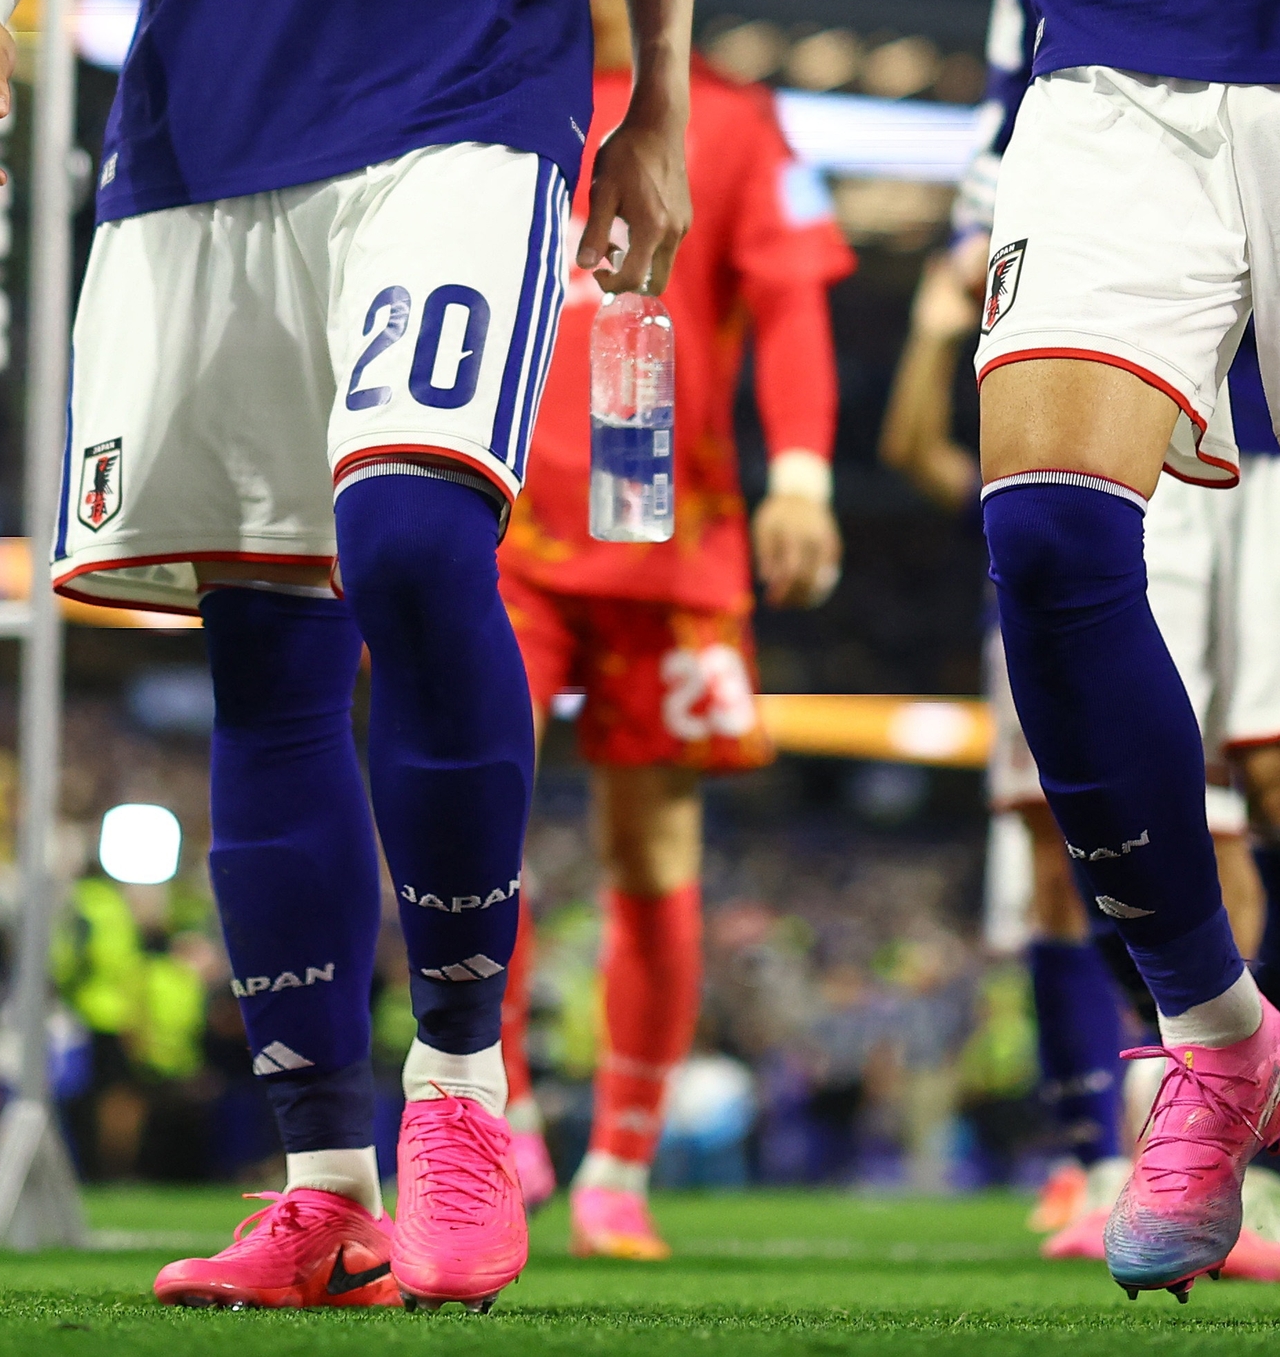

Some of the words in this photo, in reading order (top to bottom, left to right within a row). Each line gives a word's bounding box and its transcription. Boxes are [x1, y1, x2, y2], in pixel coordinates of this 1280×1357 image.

[993, 244, 1016, 263] JAPAN
[346, 284, 491, 411] 20
[93, 441, 115, 454] JAPAN
[1065, 829, 1150, 861] PAN
[231, 962, 335, 998] APAN
